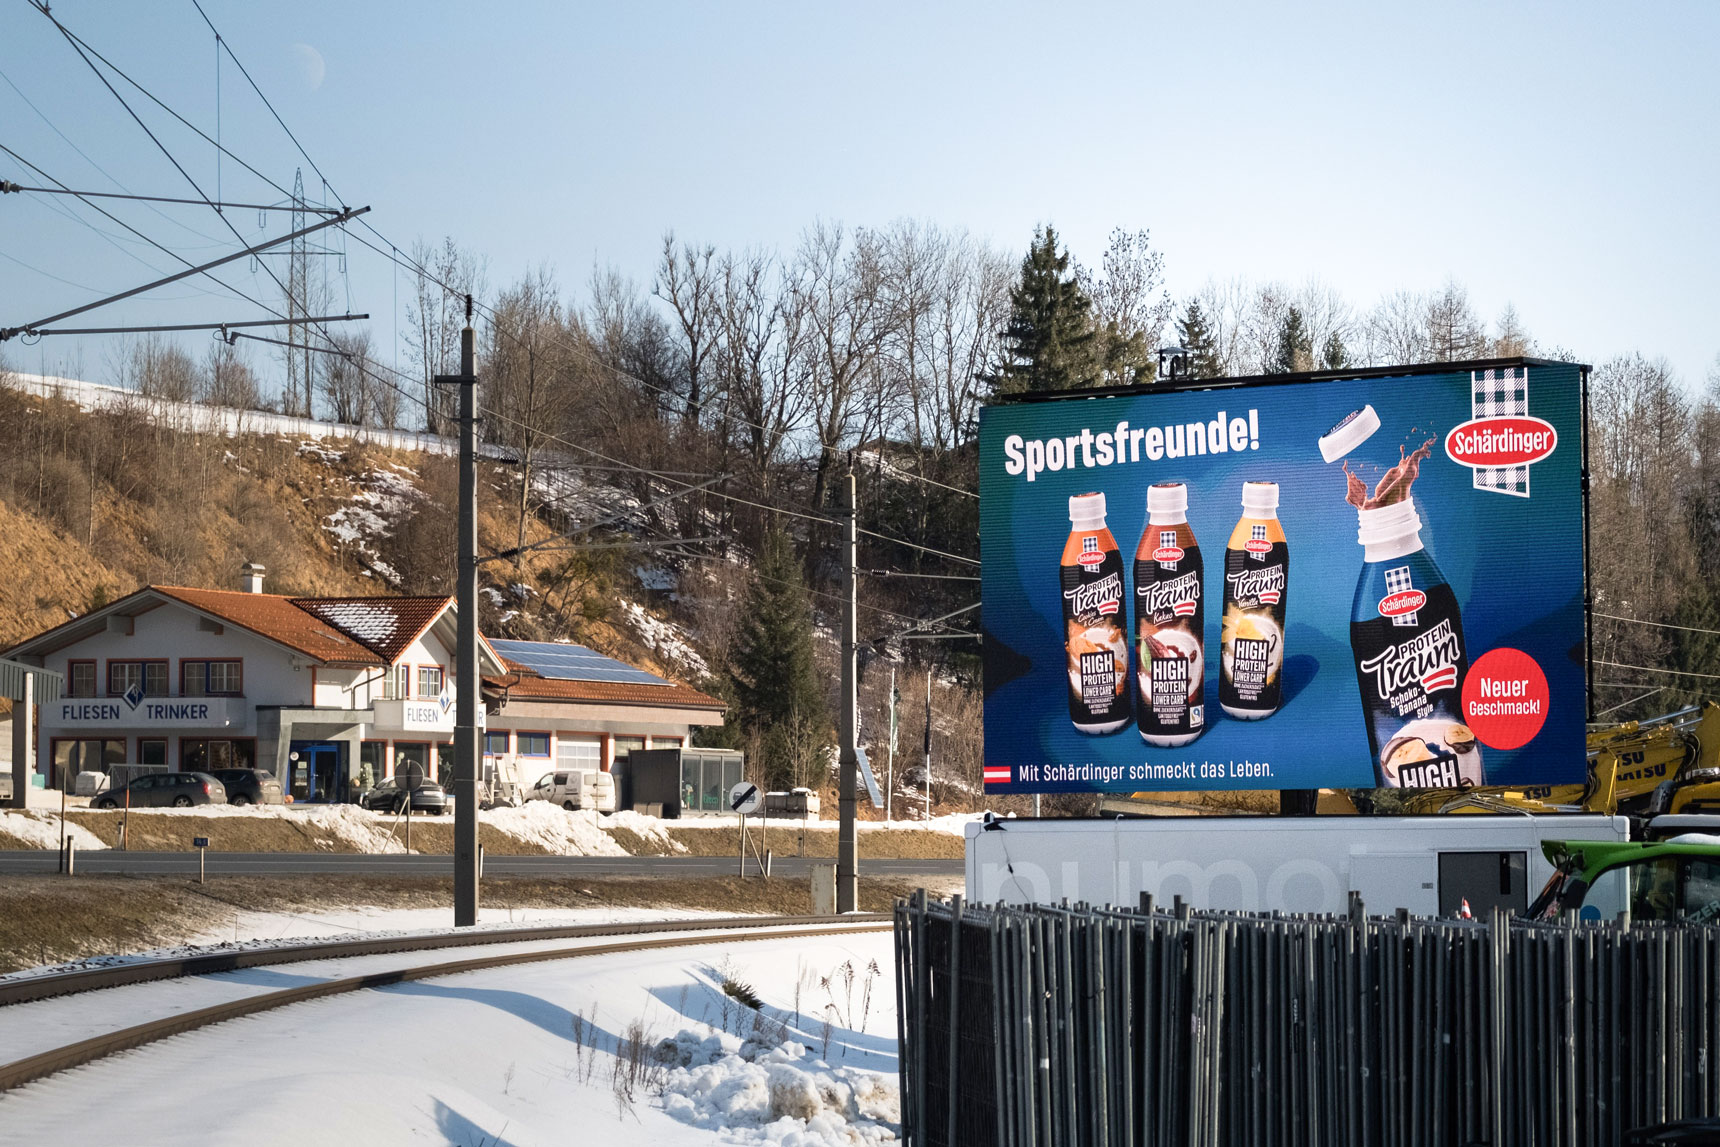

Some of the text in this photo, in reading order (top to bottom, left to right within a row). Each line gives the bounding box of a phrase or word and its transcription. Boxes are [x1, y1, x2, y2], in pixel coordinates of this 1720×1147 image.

[1004, 409, 1259, 482] Sportsfreunde!
[1455, 428, 1550, 455] Schärdinger
[1162, 572, 1196, 591] PROTEIN
[1250, 565, 1282, 581] PROTEIN
[1087, 573, 1118, 593] PROTEIN
[1227, 571, 1284, 599] Traum
[1064, 581, 1122, 615] Traum
[1137, 581, 1200, 615] Traum
[1381, 595, 1423, 613] Schärdinger
[1153, 611, 1173, 624] Kakao
[1400, 620, 1450, 658] PROTEIN
[1236, 641, 1268, 660] HIGH
[1082, 653, 1113, 674] HIGH
[1153, 660, 1186, 680] HIGH
[1235, 660, 1266, 672] PROTEIN
[1361, 633, 1460, 699] Traum
[1083, 673, 1114, 686] PROTEIN
[1234, 671, 1251, 682] LOWER
[1083, 687, 1099, 697] LOWER
[1153, 680, 1186, 693] PROTEIN
[1480, 678, 1528, 697] Neuer
[1153, 694, 1170, 705] LOWER
[1390, 688, 1421, 708] Schoko-
[1399, 694, 1427, 716] Banana
[1469, 699, 1540, 716] Geschmack!
[62, 705, 208, 720] FLIESEN TRINKER
[407, 708, 438, 722] FLIESEN
[1417, 703, 1434, 718] Style
[1019, 761, 1274, 782] Mit Schärdinger schmeckt das Leben.
[1402, 760, 1457, 787] HIGH
